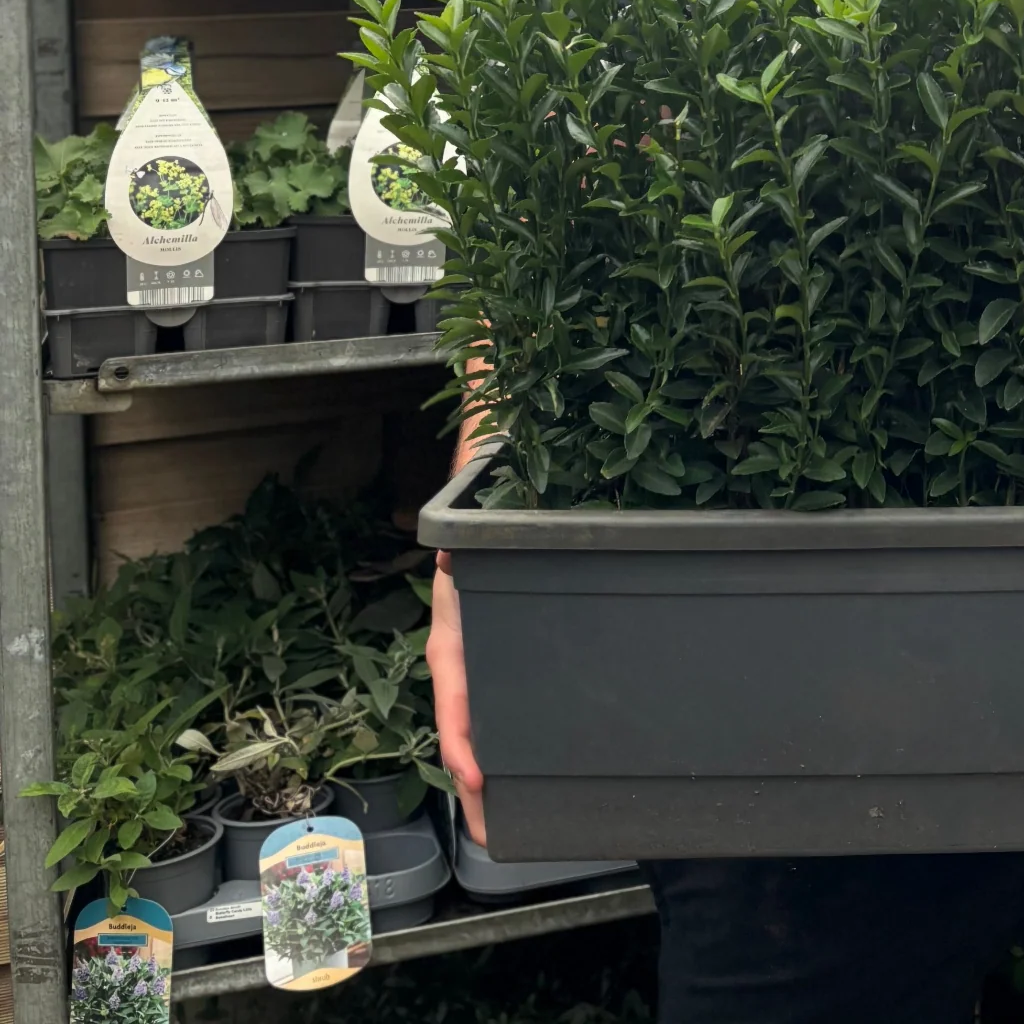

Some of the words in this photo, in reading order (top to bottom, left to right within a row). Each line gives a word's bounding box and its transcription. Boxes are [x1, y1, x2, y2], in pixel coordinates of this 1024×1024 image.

[381, 216, 433, 225] Alchemilla
[142, 234, 198, 245] Alchemilla
[297, 840, 327, 851] Buddleja
[108, 923, 137, 932] Buddleja
